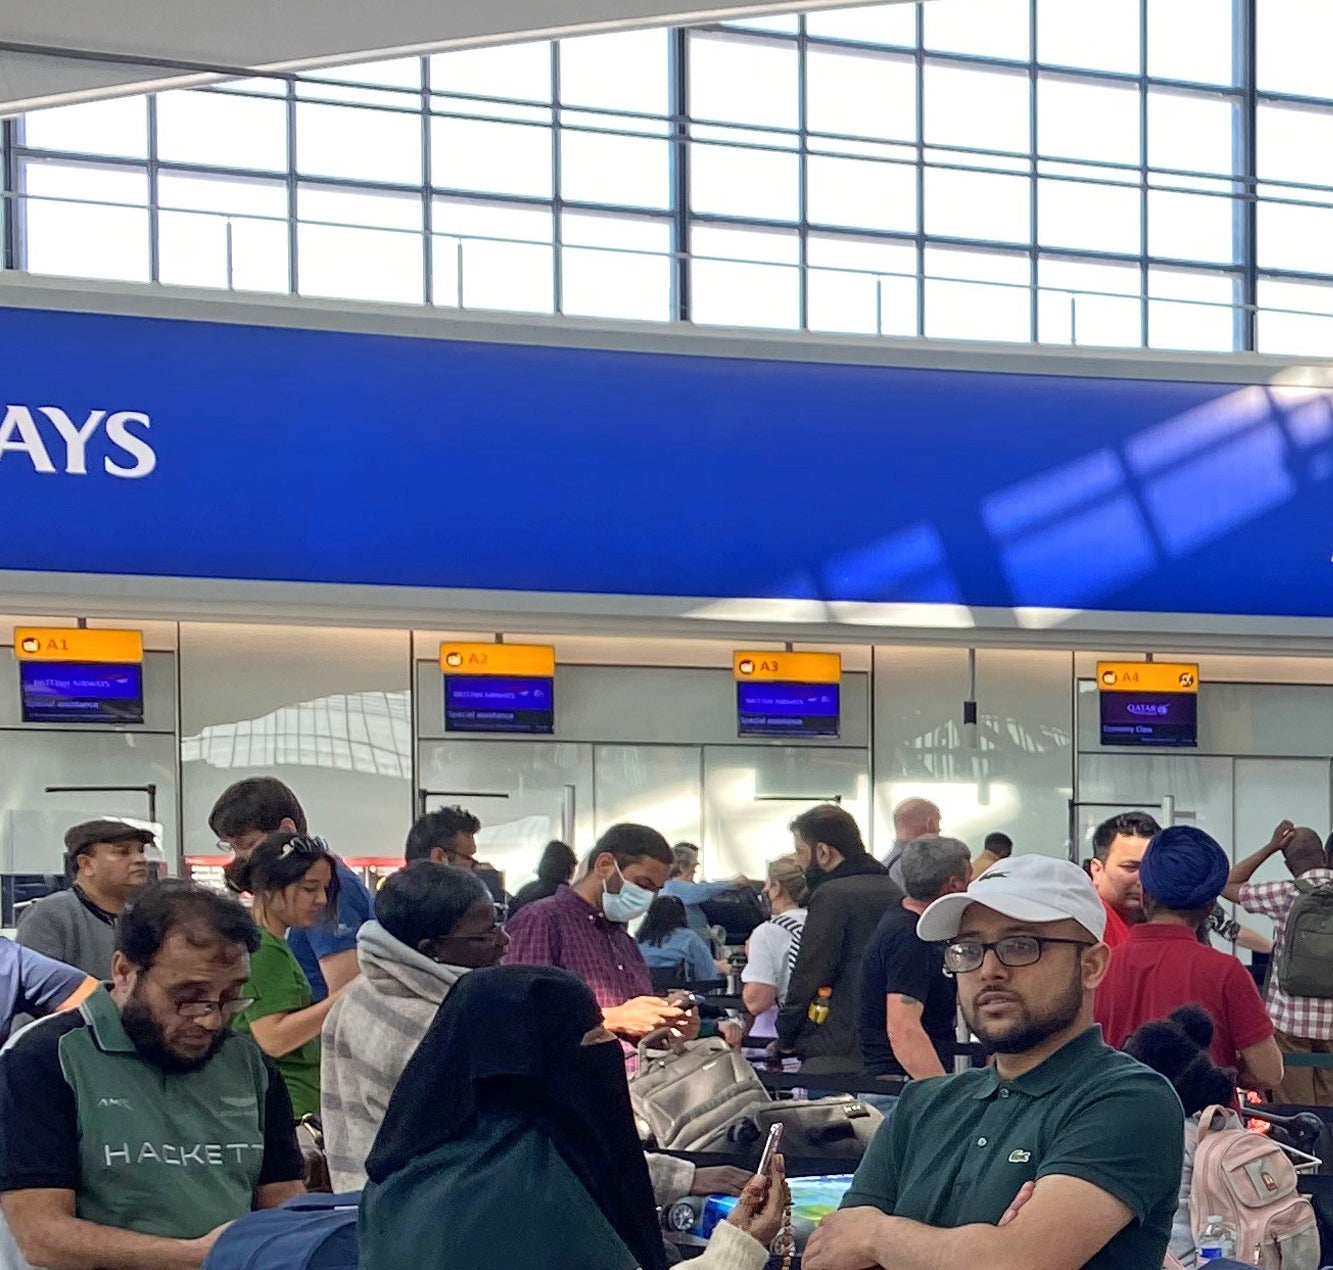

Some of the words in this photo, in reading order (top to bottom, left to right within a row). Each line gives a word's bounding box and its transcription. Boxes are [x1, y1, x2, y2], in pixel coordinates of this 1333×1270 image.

[0, 404, 157, 478] AYS
[46, 639, 69, 651] A1
[469, 653, 488, 665] A2
[760, 661, 778, 672] A3
[1122, 671, 1140, 683] A4
[1126, 703, 1156, 715] QATAR
